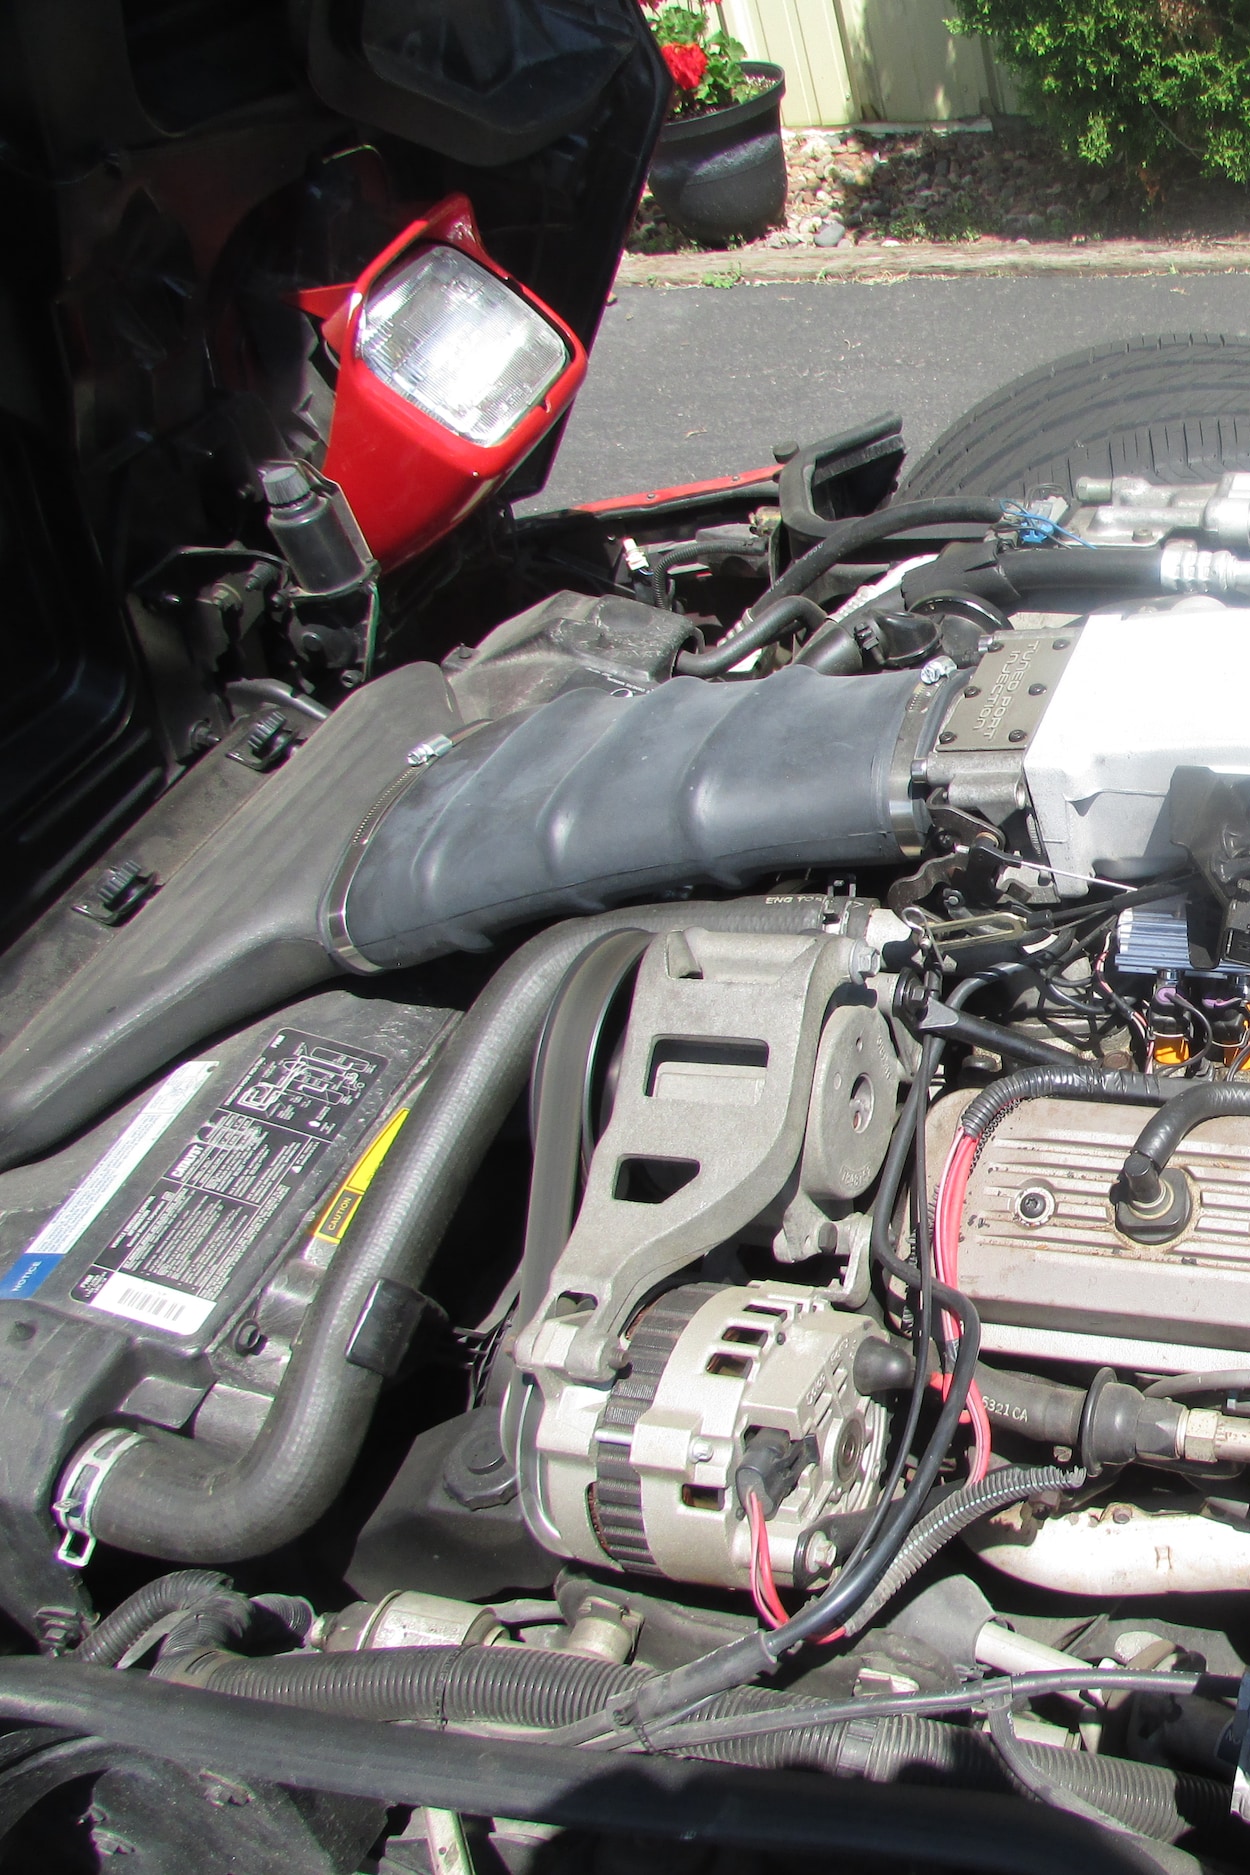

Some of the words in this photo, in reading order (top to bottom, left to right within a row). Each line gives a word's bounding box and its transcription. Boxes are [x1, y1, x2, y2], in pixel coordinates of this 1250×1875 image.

[973, 650, 1021, 731] INJECTION
[983, 696, 1013, 741] PORT
[172, 1144, 205, 1178] CATALYST
[328, 1197, 352, 1231] CAUTION
[11, 1261, 42, 1292] NOTICE
[1012, 1406, 1028, 1423] CA
